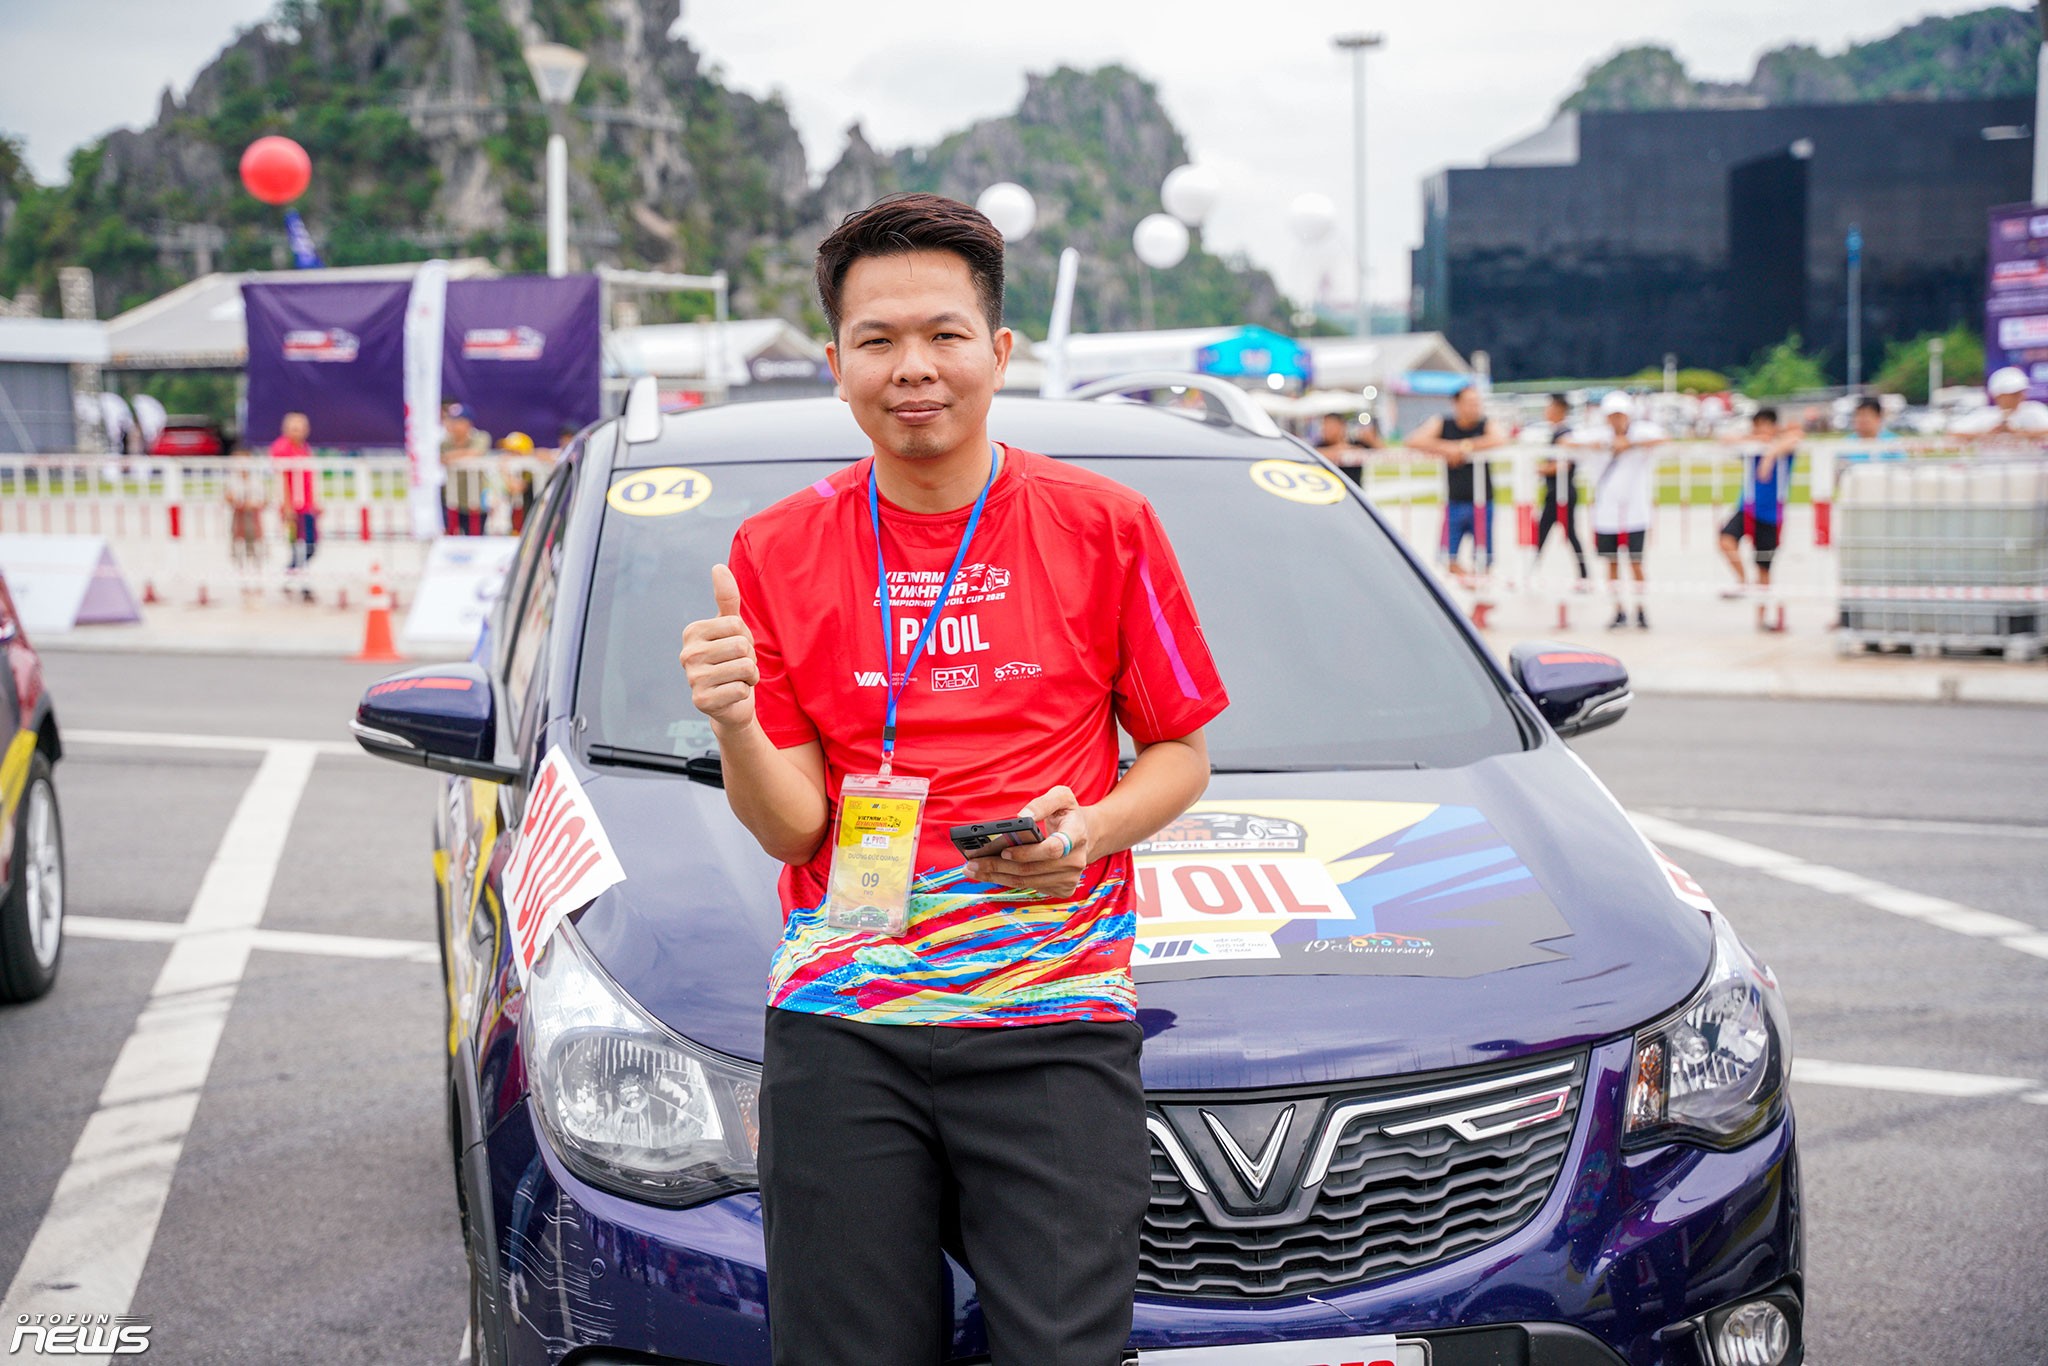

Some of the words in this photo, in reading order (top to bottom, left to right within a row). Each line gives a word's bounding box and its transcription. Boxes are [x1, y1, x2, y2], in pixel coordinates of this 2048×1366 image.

[1262, 469, 1332, 492] 09
[622, 479, 700, 503] 04
[965, 595, 984, 604] CUP
[985, 592, 1006, 602] 2025
[900, 613, 991, 656] PVOIL
[934, 667, 975, 681] OTV
[935, 677, 977, 688] MEDIA
[861, 872, 880, 888] 09
[1136, 864, 1332, 919] VOIL
